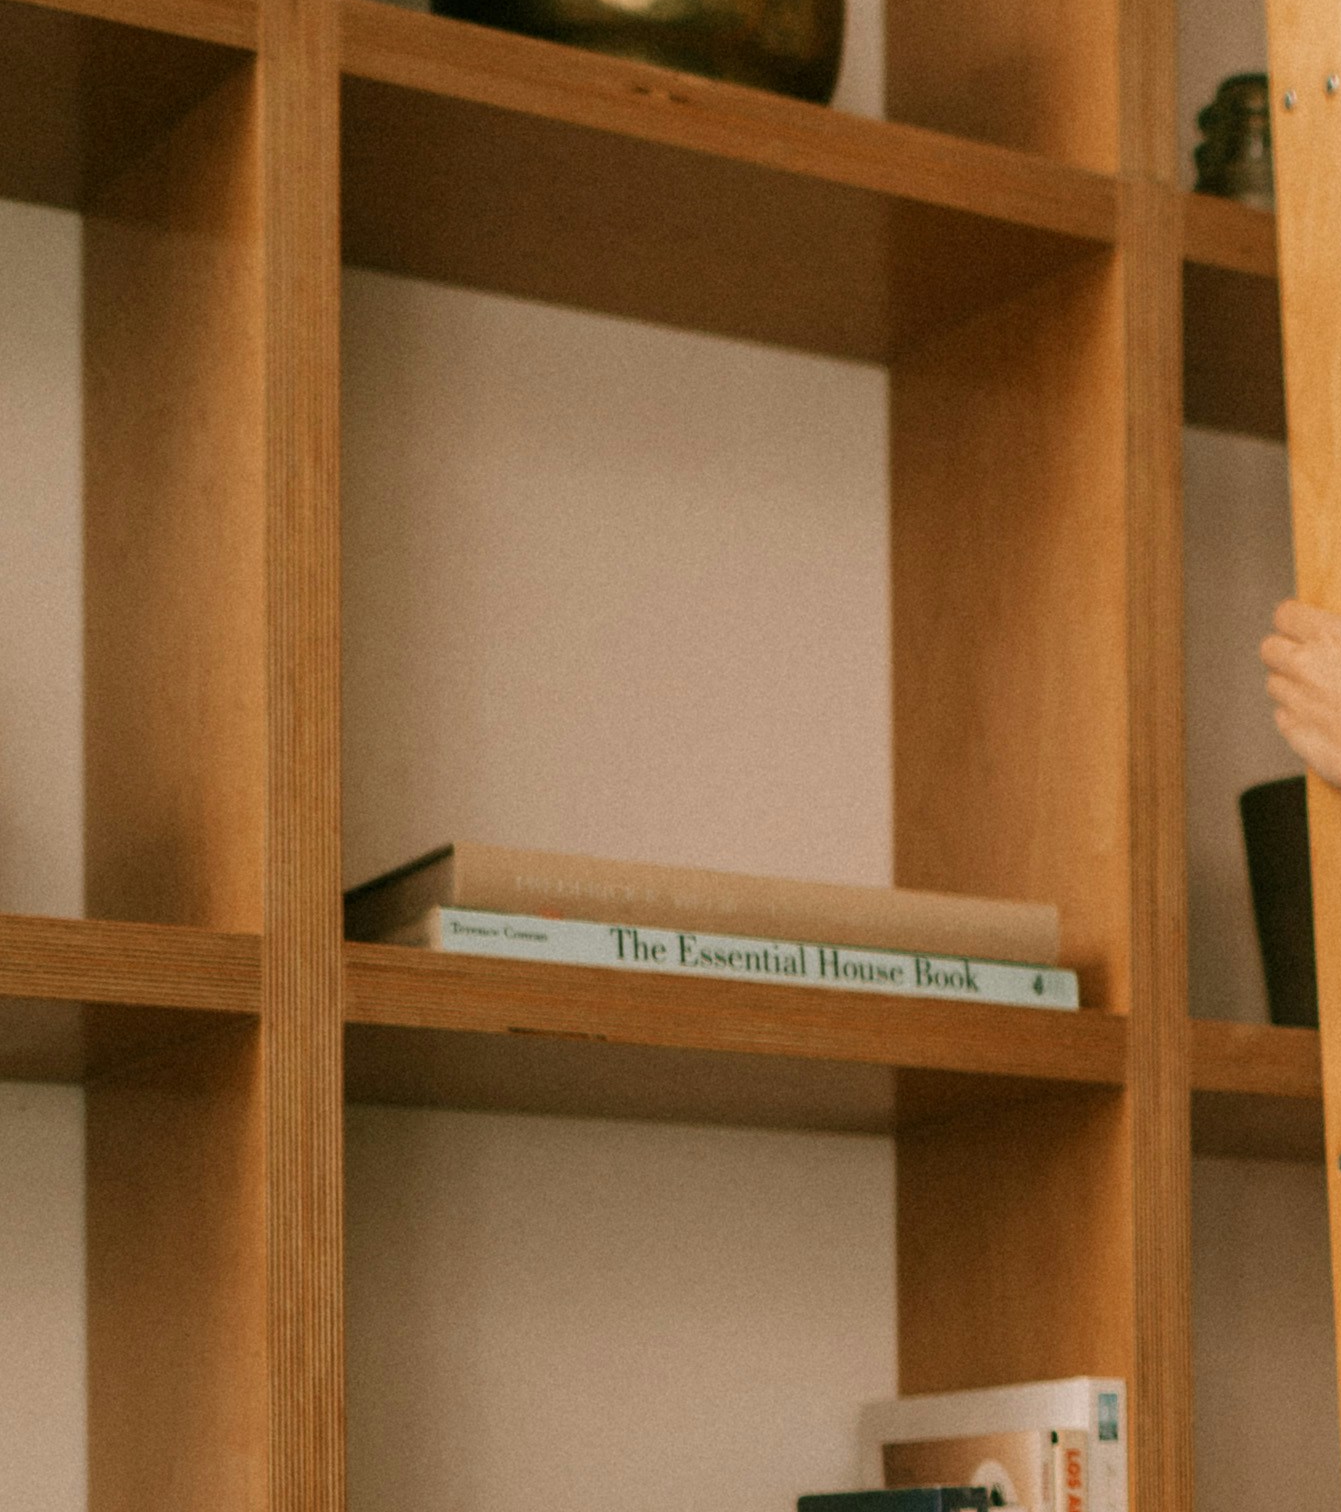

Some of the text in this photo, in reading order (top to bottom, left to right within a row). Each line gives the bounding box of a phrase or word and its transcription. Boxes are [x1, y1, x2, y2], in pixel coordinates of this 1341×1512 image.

[610, 926, 980, 993] The Essential House Book
[1065, 1447, 1082, 1489] LOS
